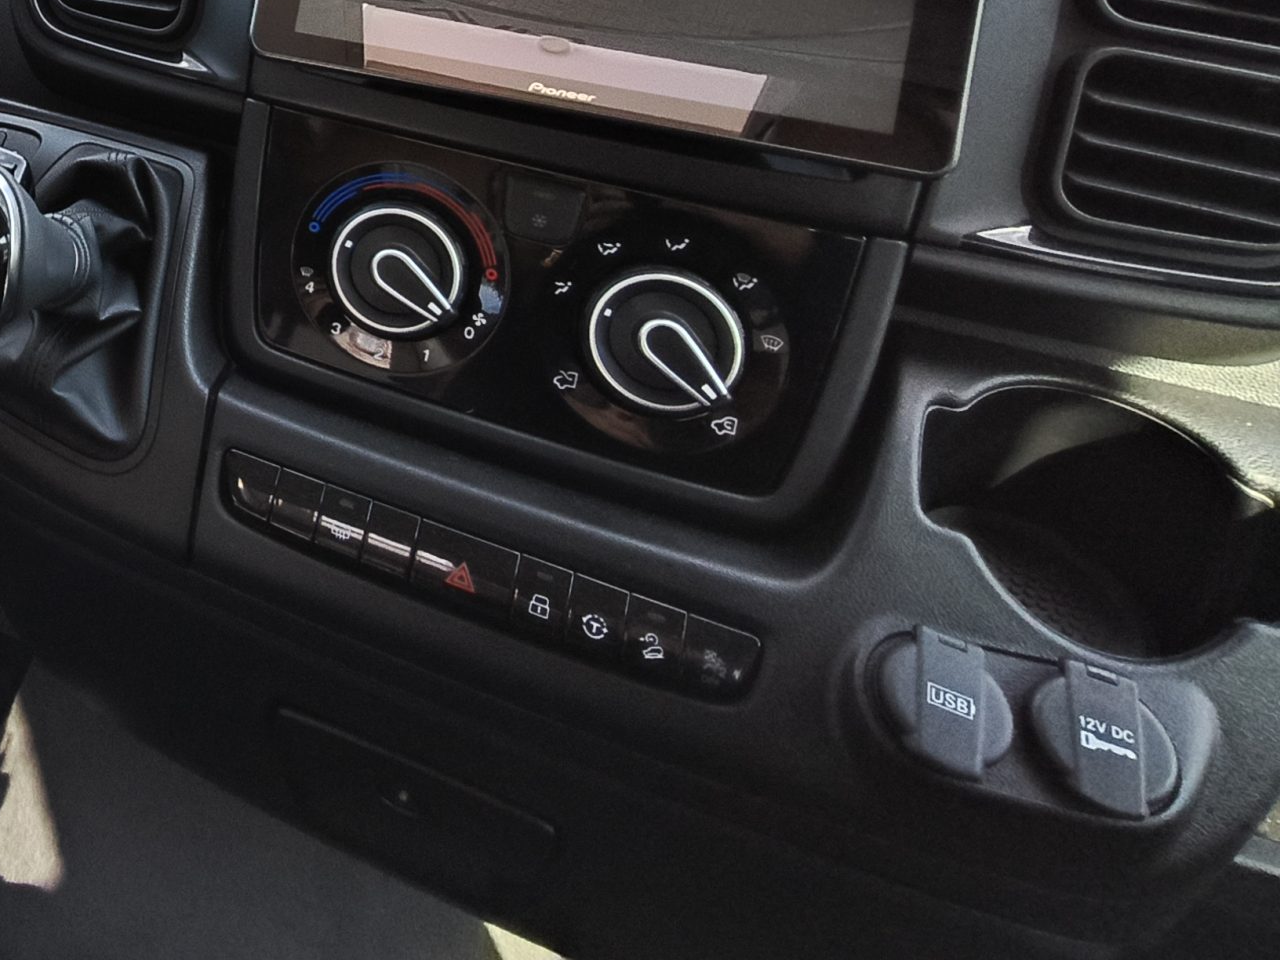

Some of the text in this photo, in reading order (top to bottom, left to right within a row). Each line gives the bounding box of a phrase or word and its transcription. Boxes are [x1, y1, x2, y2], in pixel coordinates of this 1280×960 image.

[528, 82, 597, 102] Pioneer
[304, 281, 315, 294] 4
[330, 322, 342, 335] 3
[464, 326, 475, 339] 0
[373, 348, 384, 360] 2
[422, 349, 430, 362] 1
[931, 687, 969, 714] USB
[1079, 715, 1136, 744] 12V DC
